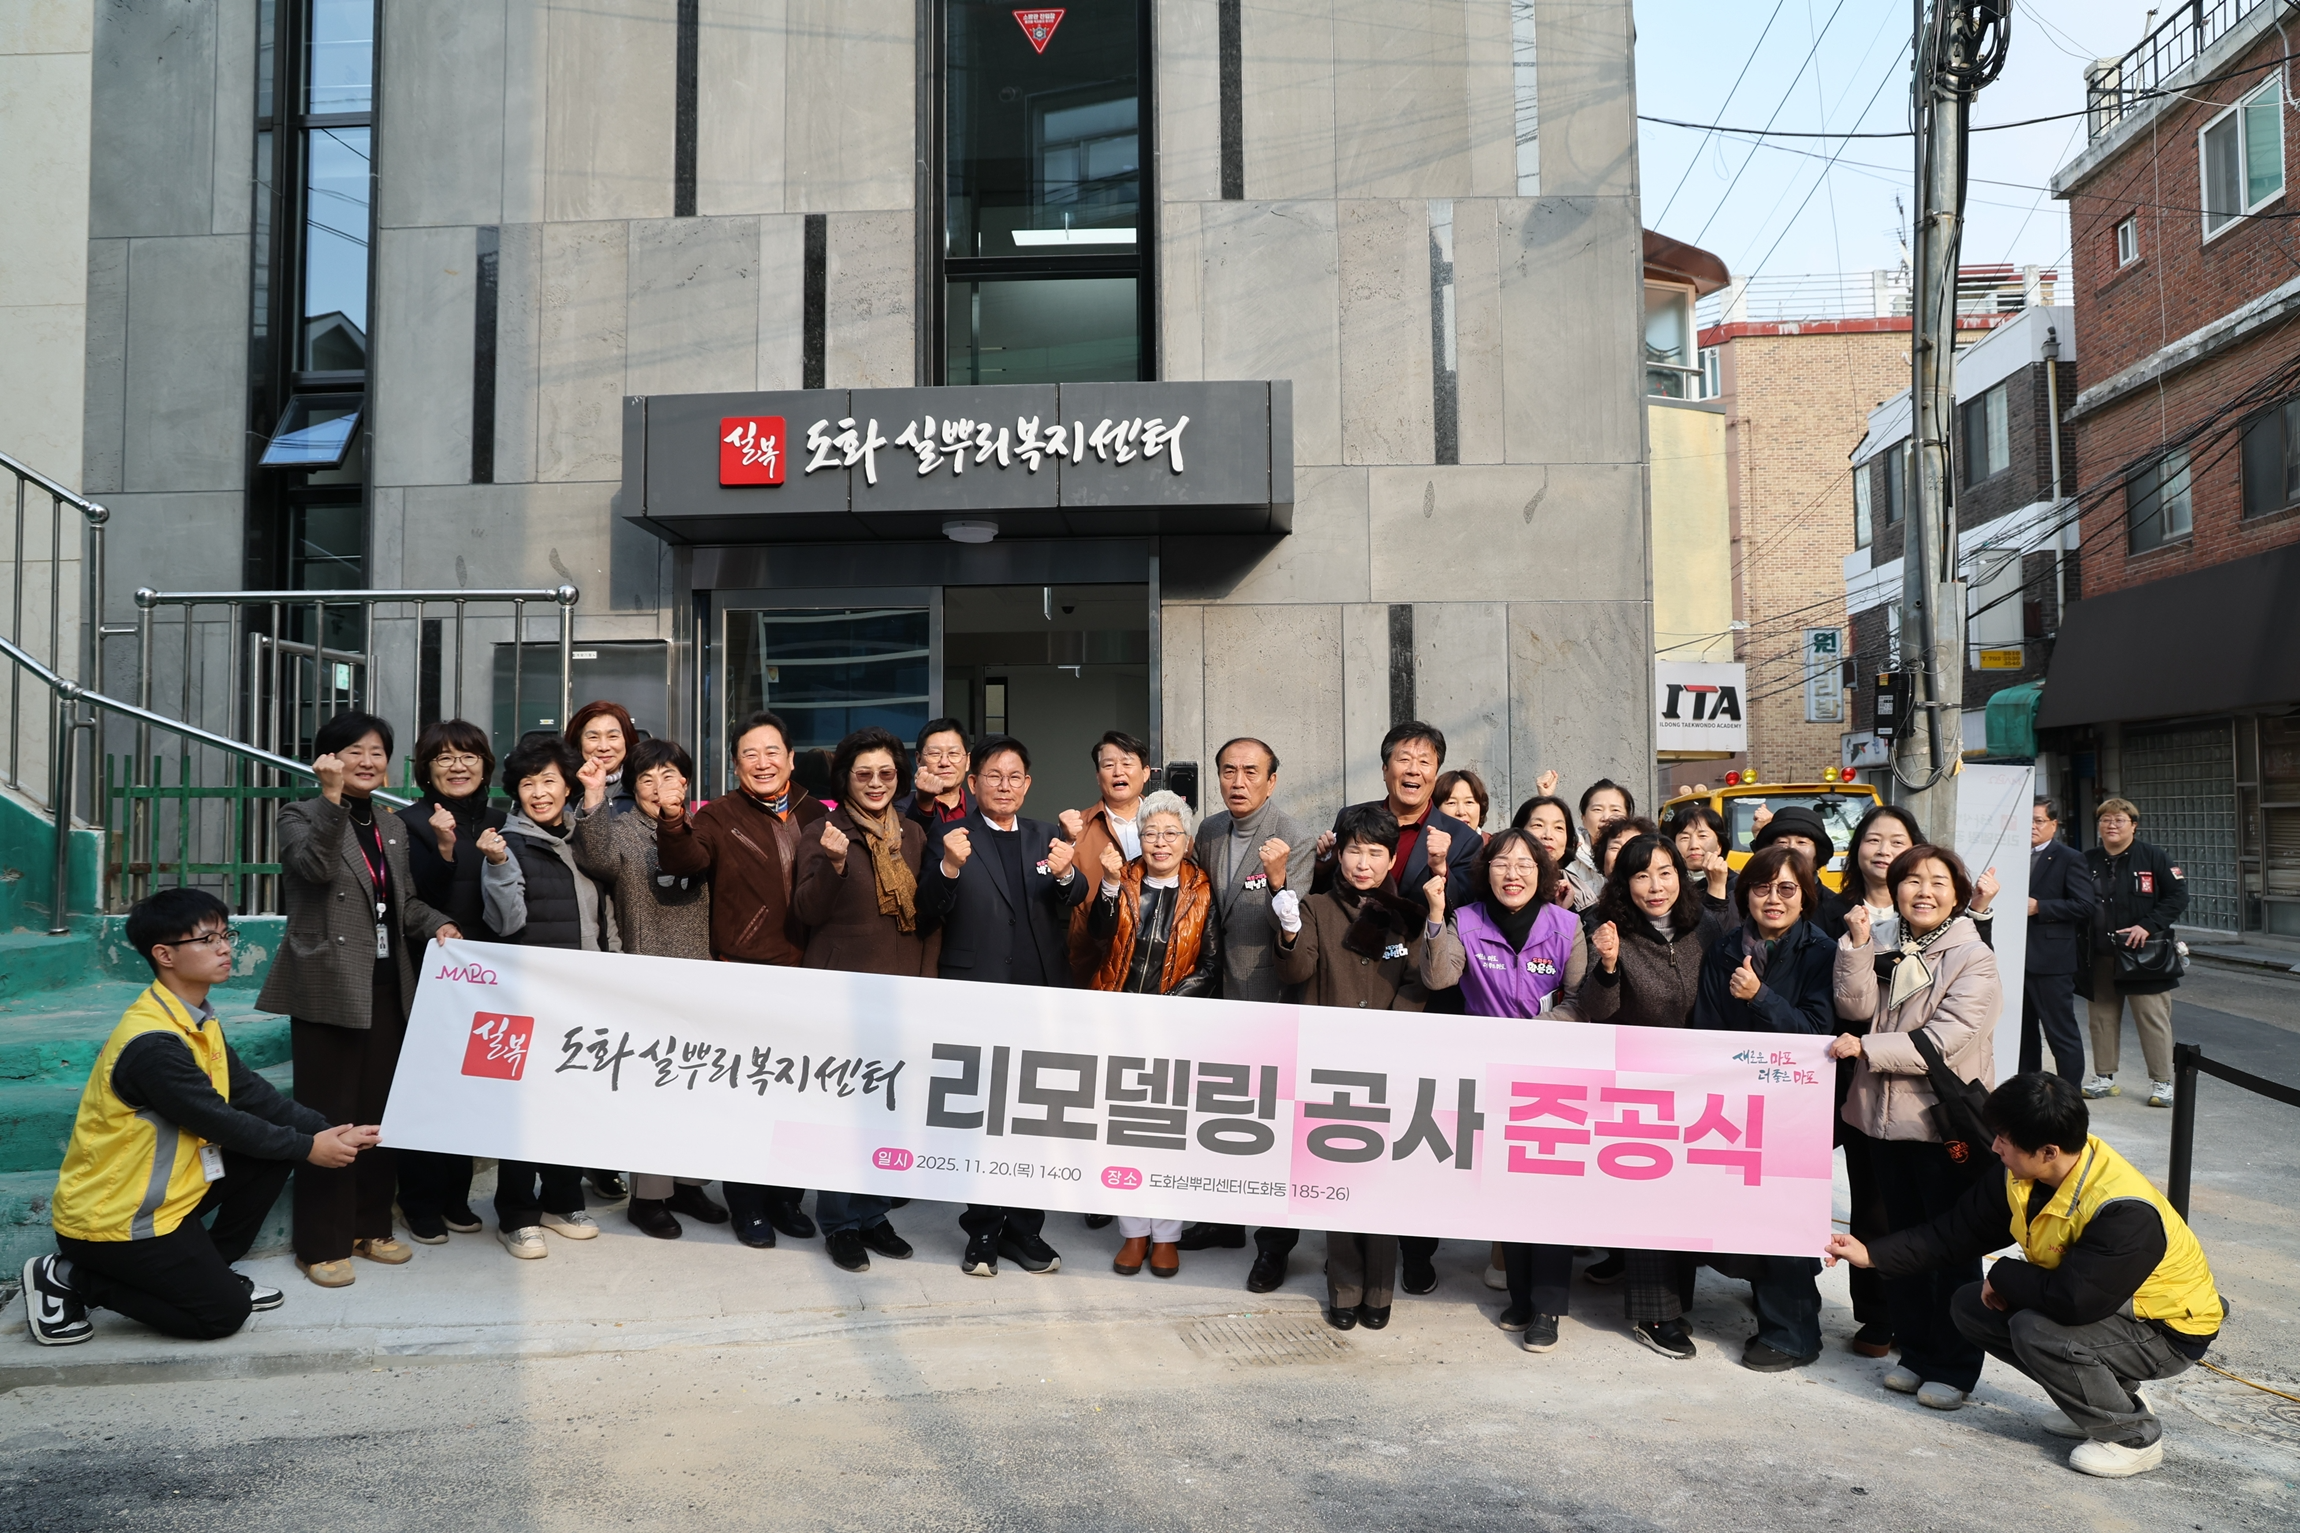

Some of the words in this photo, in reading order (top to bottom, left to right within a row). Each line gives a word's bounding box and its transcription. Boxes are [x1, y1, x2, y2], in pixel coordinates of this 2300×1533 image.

[722, 420, 781, 480] 실복
[804, 415, 888, 484] 도화
[894, 414, 1190, 476] 실뿌리복지센터
[1661, 683, 1742, 722] ITA
[435, 963, 498, 986] MAPO
[472, 1016, 528, 1077] 실복
[1732, 1049, 1768, 1064] 새로운
[1770, 1050, 1797, 1066] 마포
[1758, 1068, 1770, 1083] 더
[1772, 1068, 1792, 1083] 좋은
[1793, 1069, 1819, 1085] 마포
[554, 1026, 636, 1092] 도화
[637, 1034, 907, 1111] 실뿌리복지센터
[925, 1042, 1279, 1156] 리모델링
[1303, 1068, 1485, 1171] 공사
[1504, 1080, 1766, 1187] 준공식
[916, 1154, 960, 1172] 2025.
[963, 1158, 986, 1174] 11.
[988, 1160, 1035, 1179] 20.(목)
[1039, 1164, 1083, 1182] 14:00
[1149, 1173, 1288, 1198] 도화실뿌리센터(도화동
[1290, 1183, 1351, 1203] 185-26)
